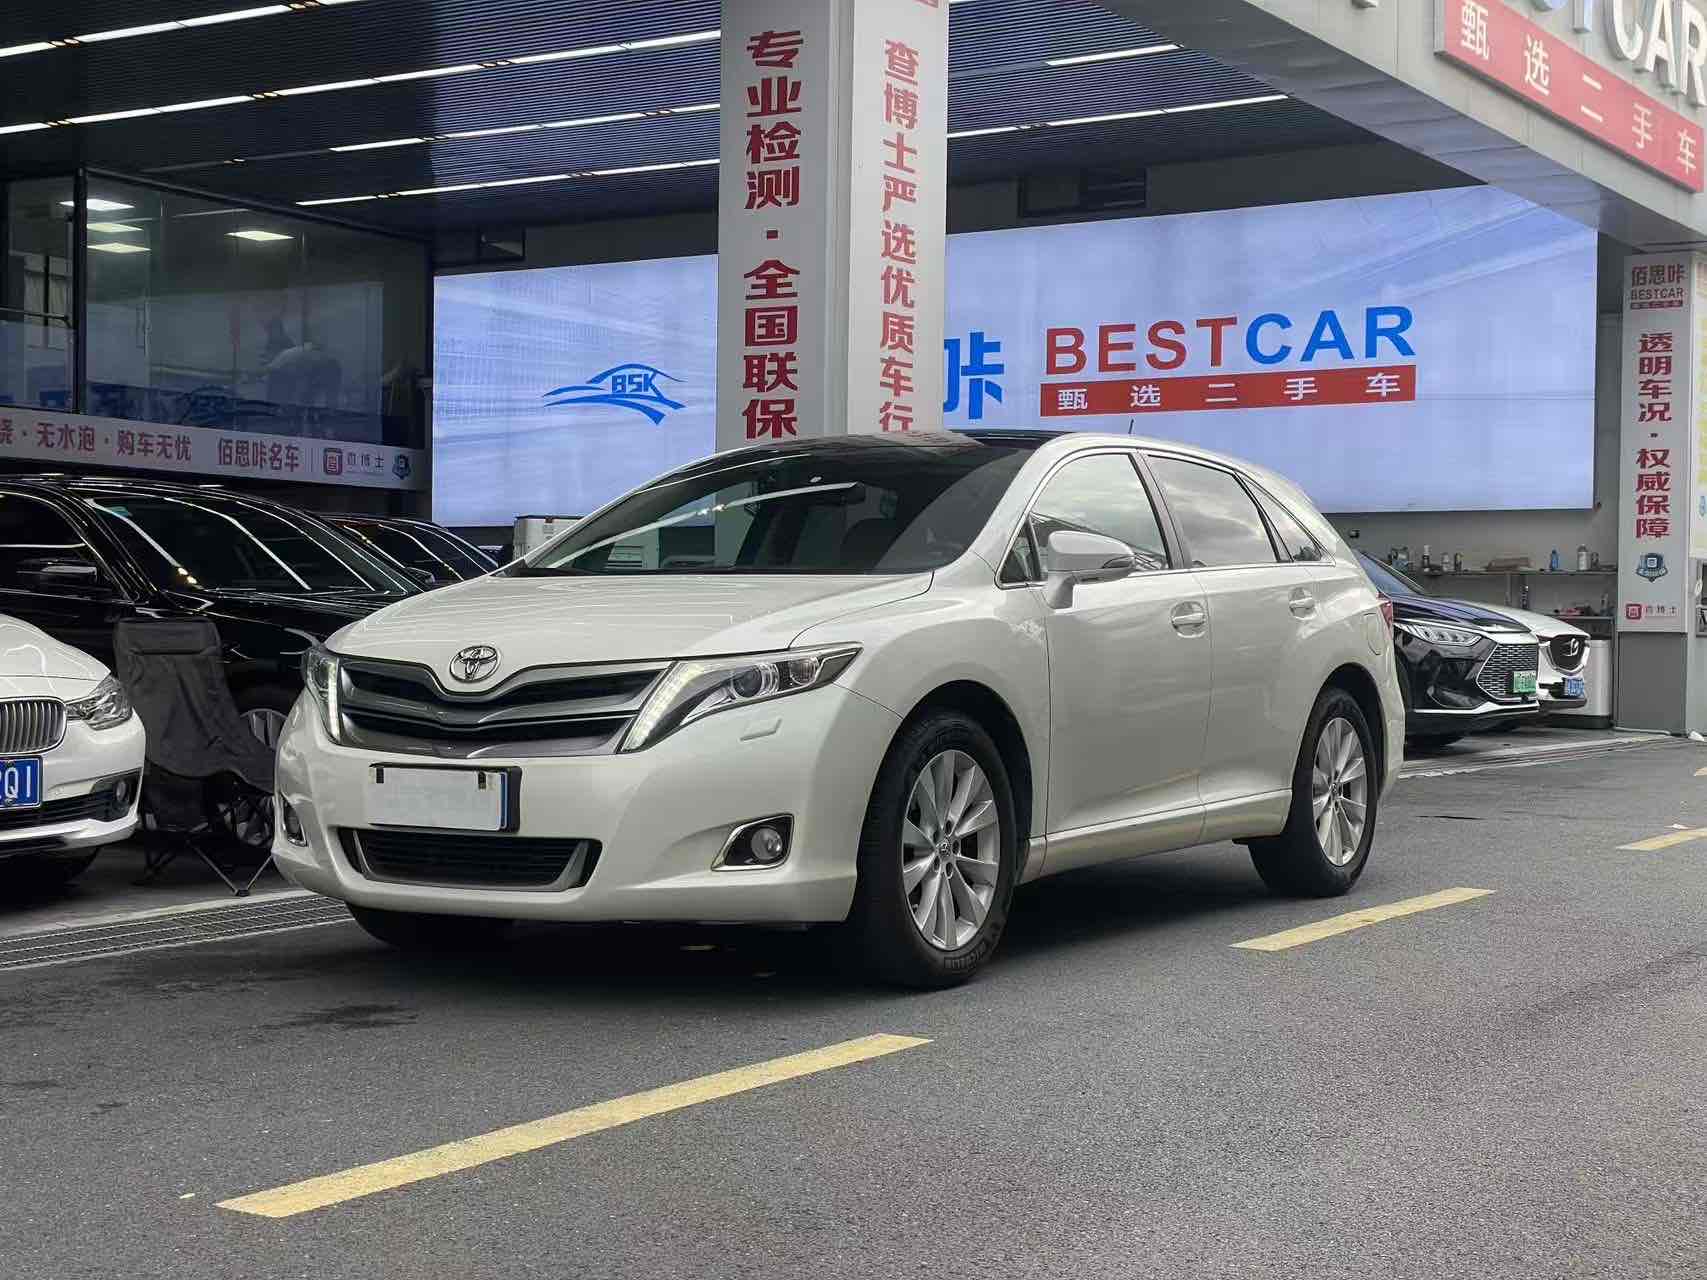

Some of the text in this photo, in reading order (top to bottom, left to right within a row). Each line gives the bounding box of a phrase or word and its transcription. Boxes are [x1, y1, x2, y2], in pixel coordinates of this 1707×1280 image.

[1460, 3, 1697, 175] 甄选二手车
[880, 40, 919, 433] 查博士严选优质车行
[1631, 287, 1684, 301] BESTCAR
[1045, 305, 1416, 375] BESTCAR
[611, 371, 664, 399] BSK
[1057, 372, 1401, 410] 甄选二手车
[217, 438, 299, 473] 佰思咔名车
[0, 766, 31, 799] Q1
